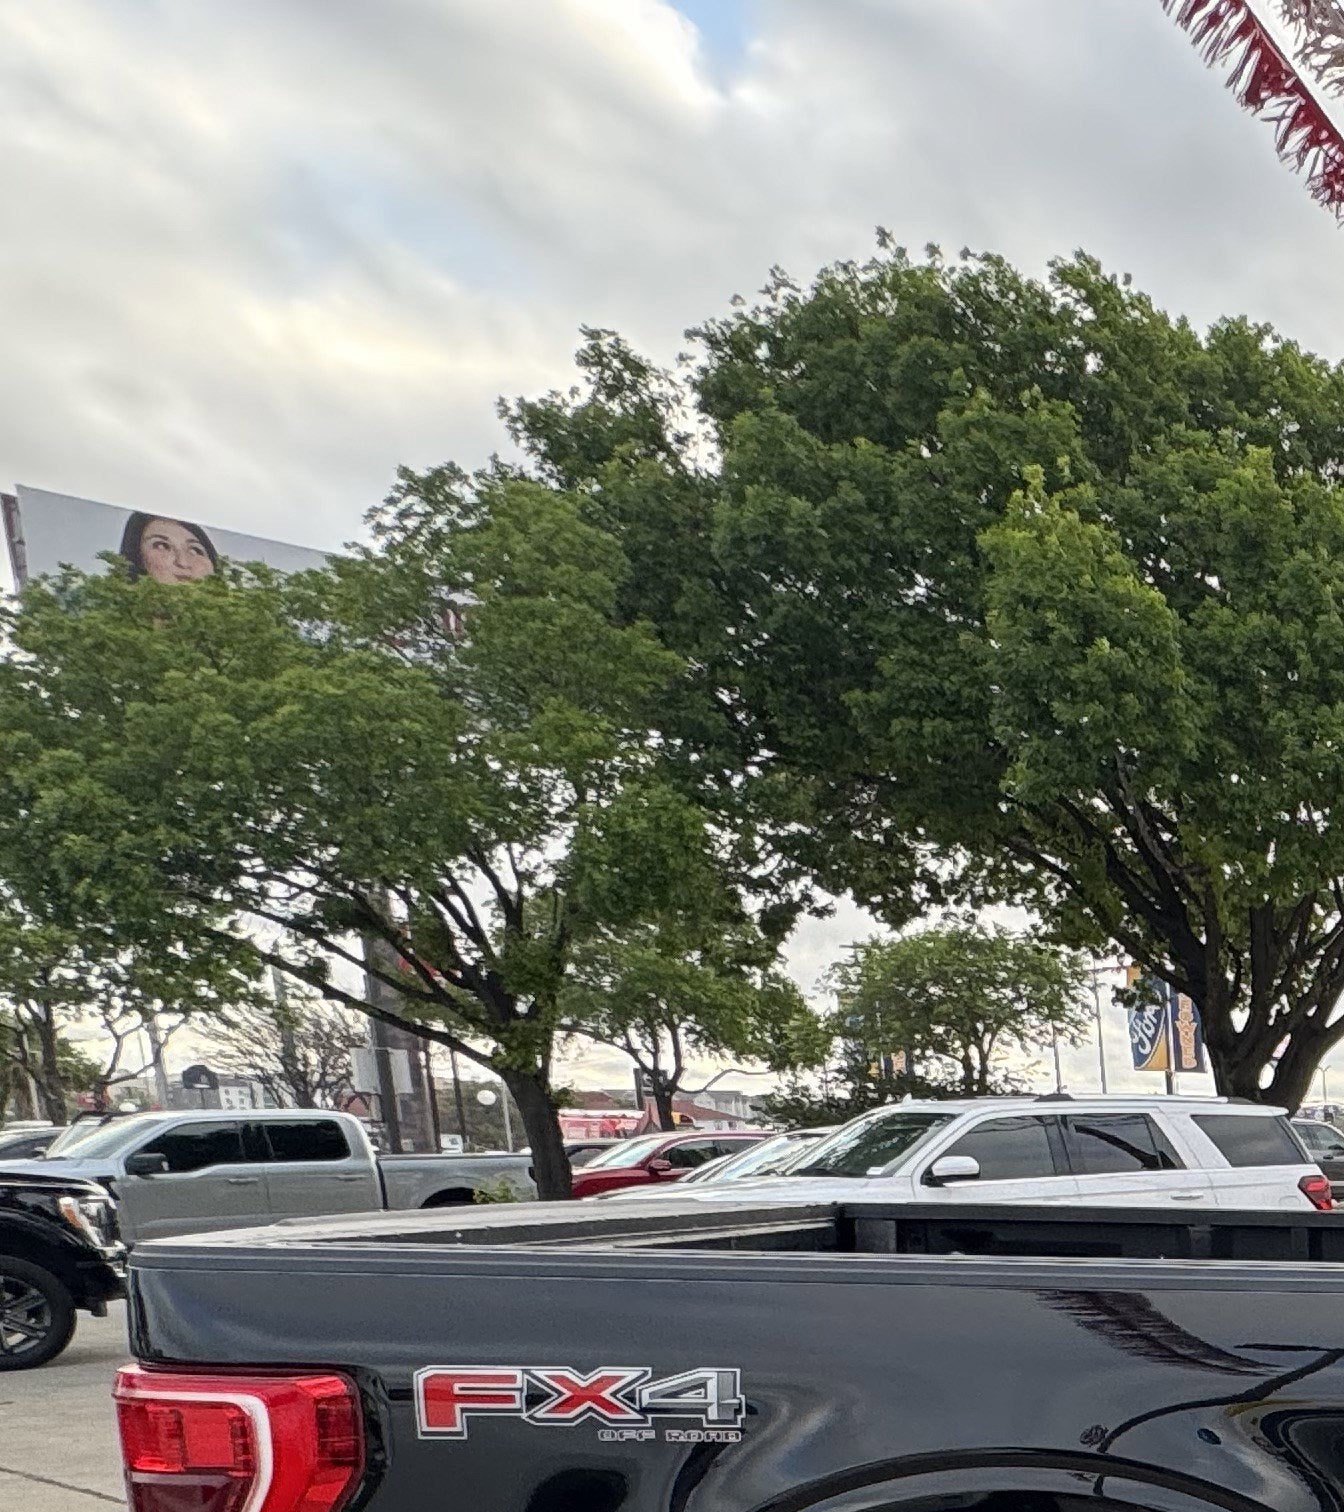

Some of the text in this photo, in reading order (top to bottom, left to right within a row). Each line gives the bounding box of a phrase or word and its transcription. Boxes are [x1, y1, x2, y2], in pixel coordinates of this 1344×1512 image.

[1130, 988, 1163, 1056] For
[413, 1365, 746, 1440] FX4
[597, 1429, 742, 1443] OFF ROAD
